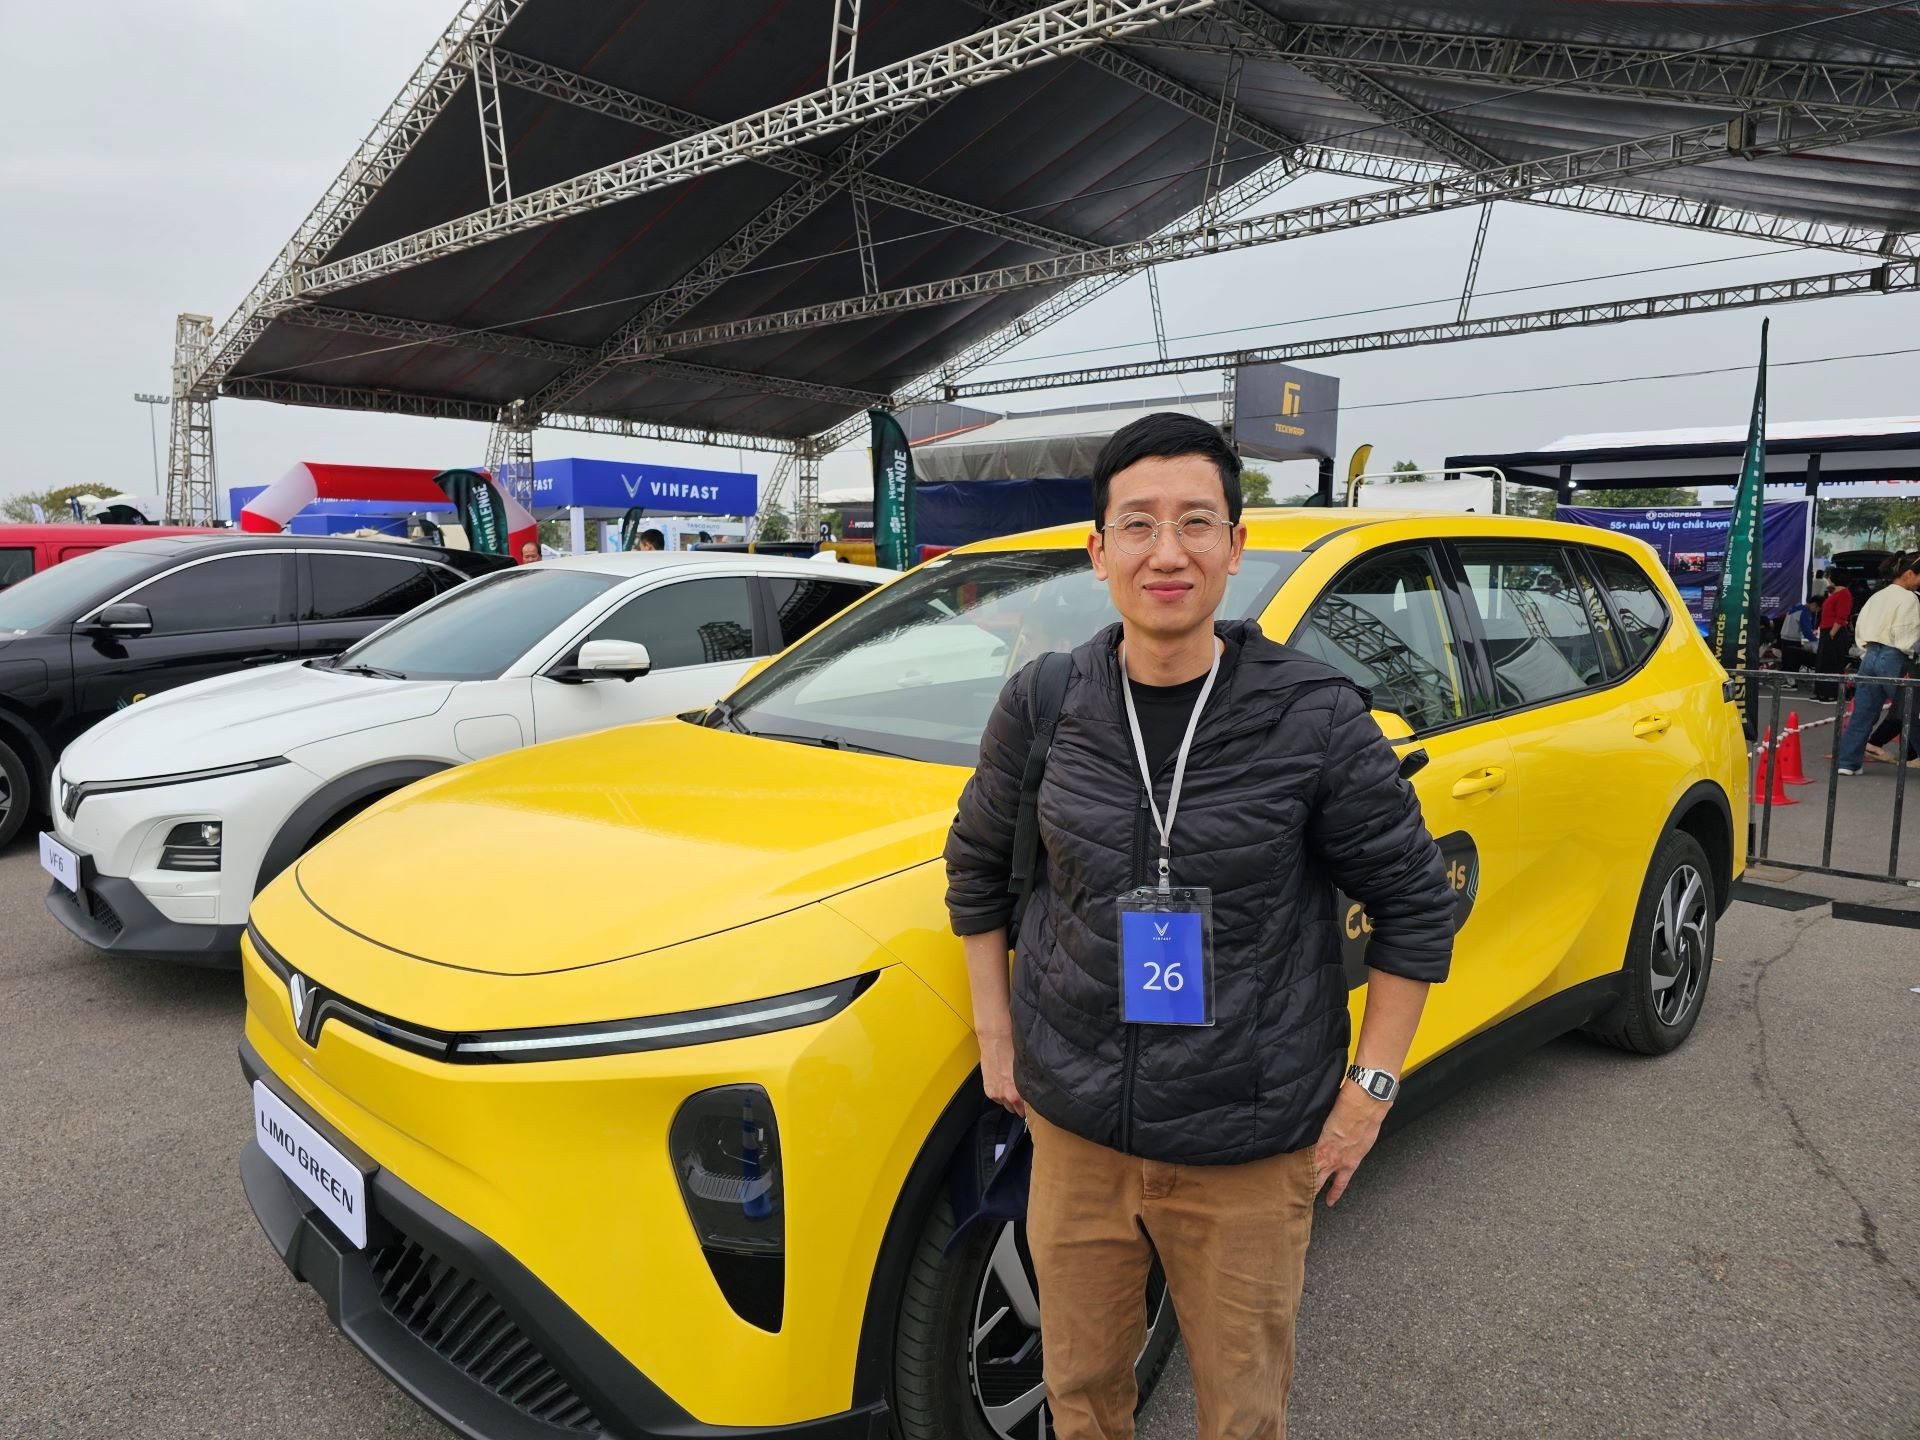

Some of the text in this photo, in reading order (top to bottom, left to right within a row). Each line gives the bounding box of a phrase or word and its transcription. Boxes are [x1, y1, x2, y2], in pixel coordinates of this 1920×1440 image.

[516, 478, 553, 492] VFAST
[651, 481, 719, 500] VINFAST
[472, 483, 497, 551] CHALLENGE
[1610, 521, 1627, 529] 55+
[1629, 520, 1650, 529] năm
[1652, 520, 1666, 531] Uy
[1714, 613, 1726, 661] wards
[49, 848, 64, 872] VF6
[1142, 961, 1184, 991] 26
[261, 1109, 354, 1215] LIMO GREEN
